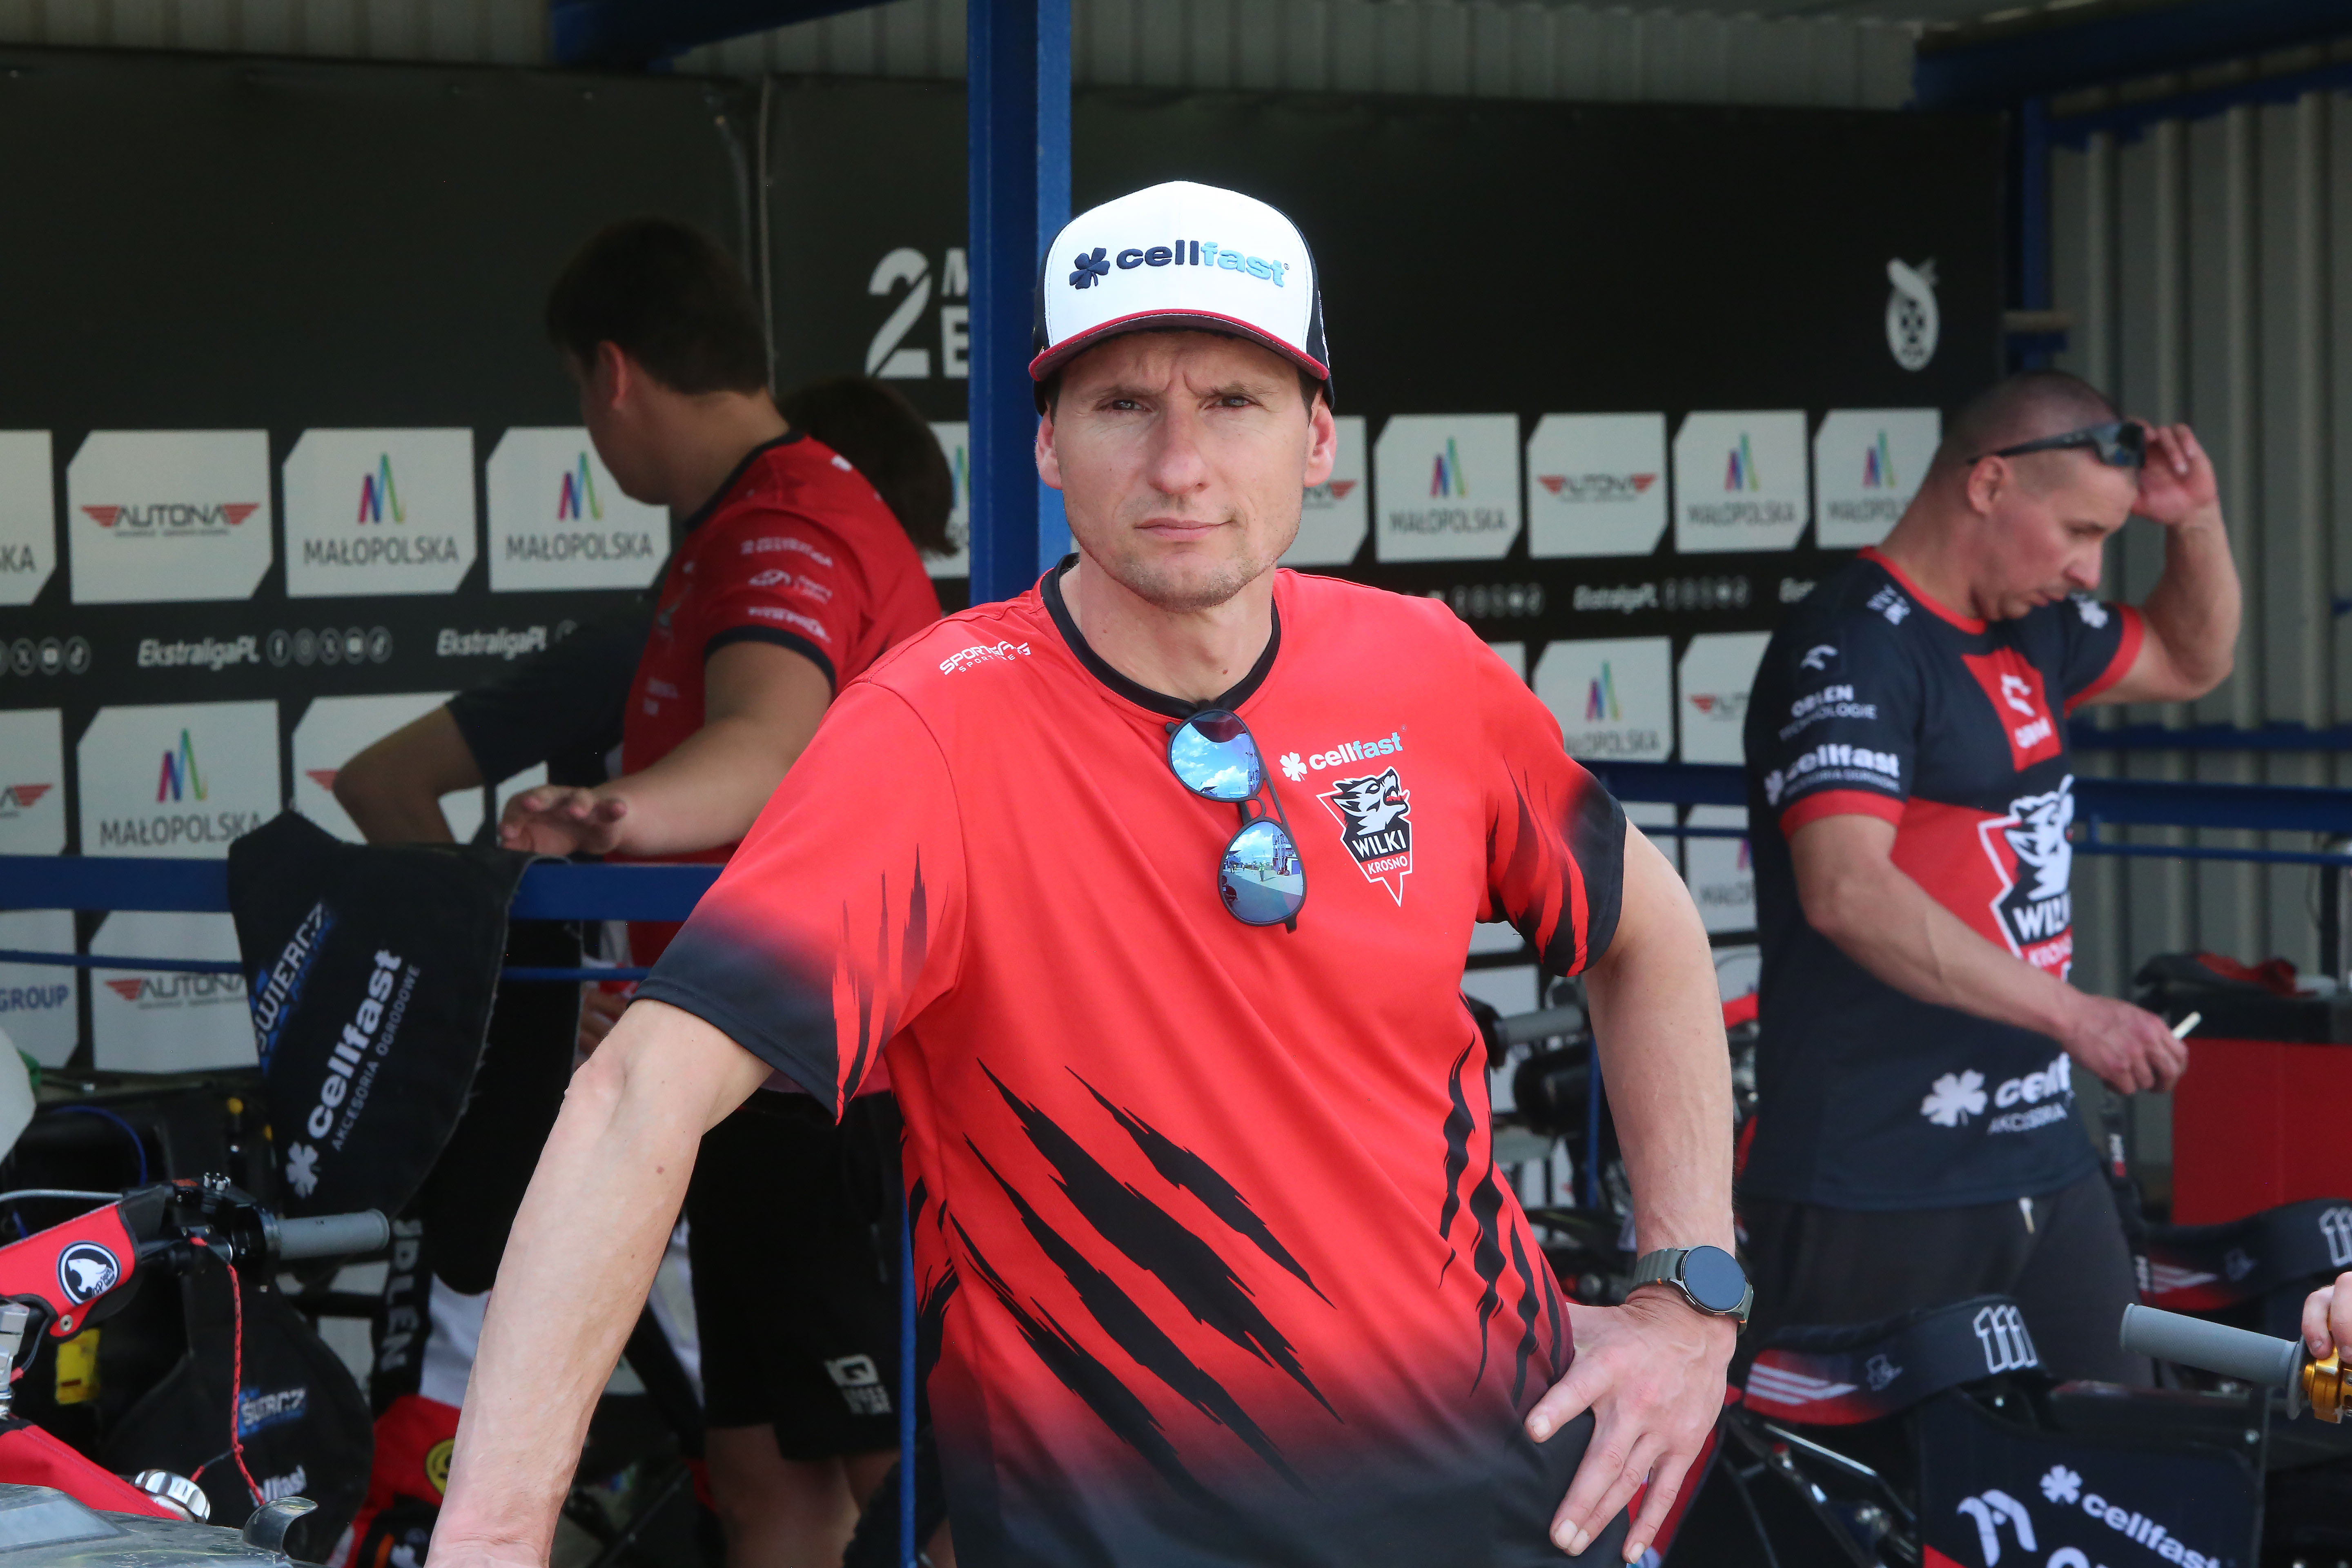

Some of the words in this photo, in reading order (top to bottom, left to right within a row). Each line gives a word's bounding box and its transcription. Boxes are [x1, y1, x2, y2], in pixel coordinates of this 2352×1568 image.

[1116, 239, 1285, 287] cellfast
[114, 503, 231, 527] AUTONA
[303, 535, 459, 566] MAŁOPOLSKA
[506, 532, 653, 561] MAŁOPOLSKA
[1309, 732, 1403, 770] cellfast
[1352, 829, 1407, 858] WILKI
[1367, 855, 1408, 875] KROSNO
[307, 949, 402, 1139] cellfast
